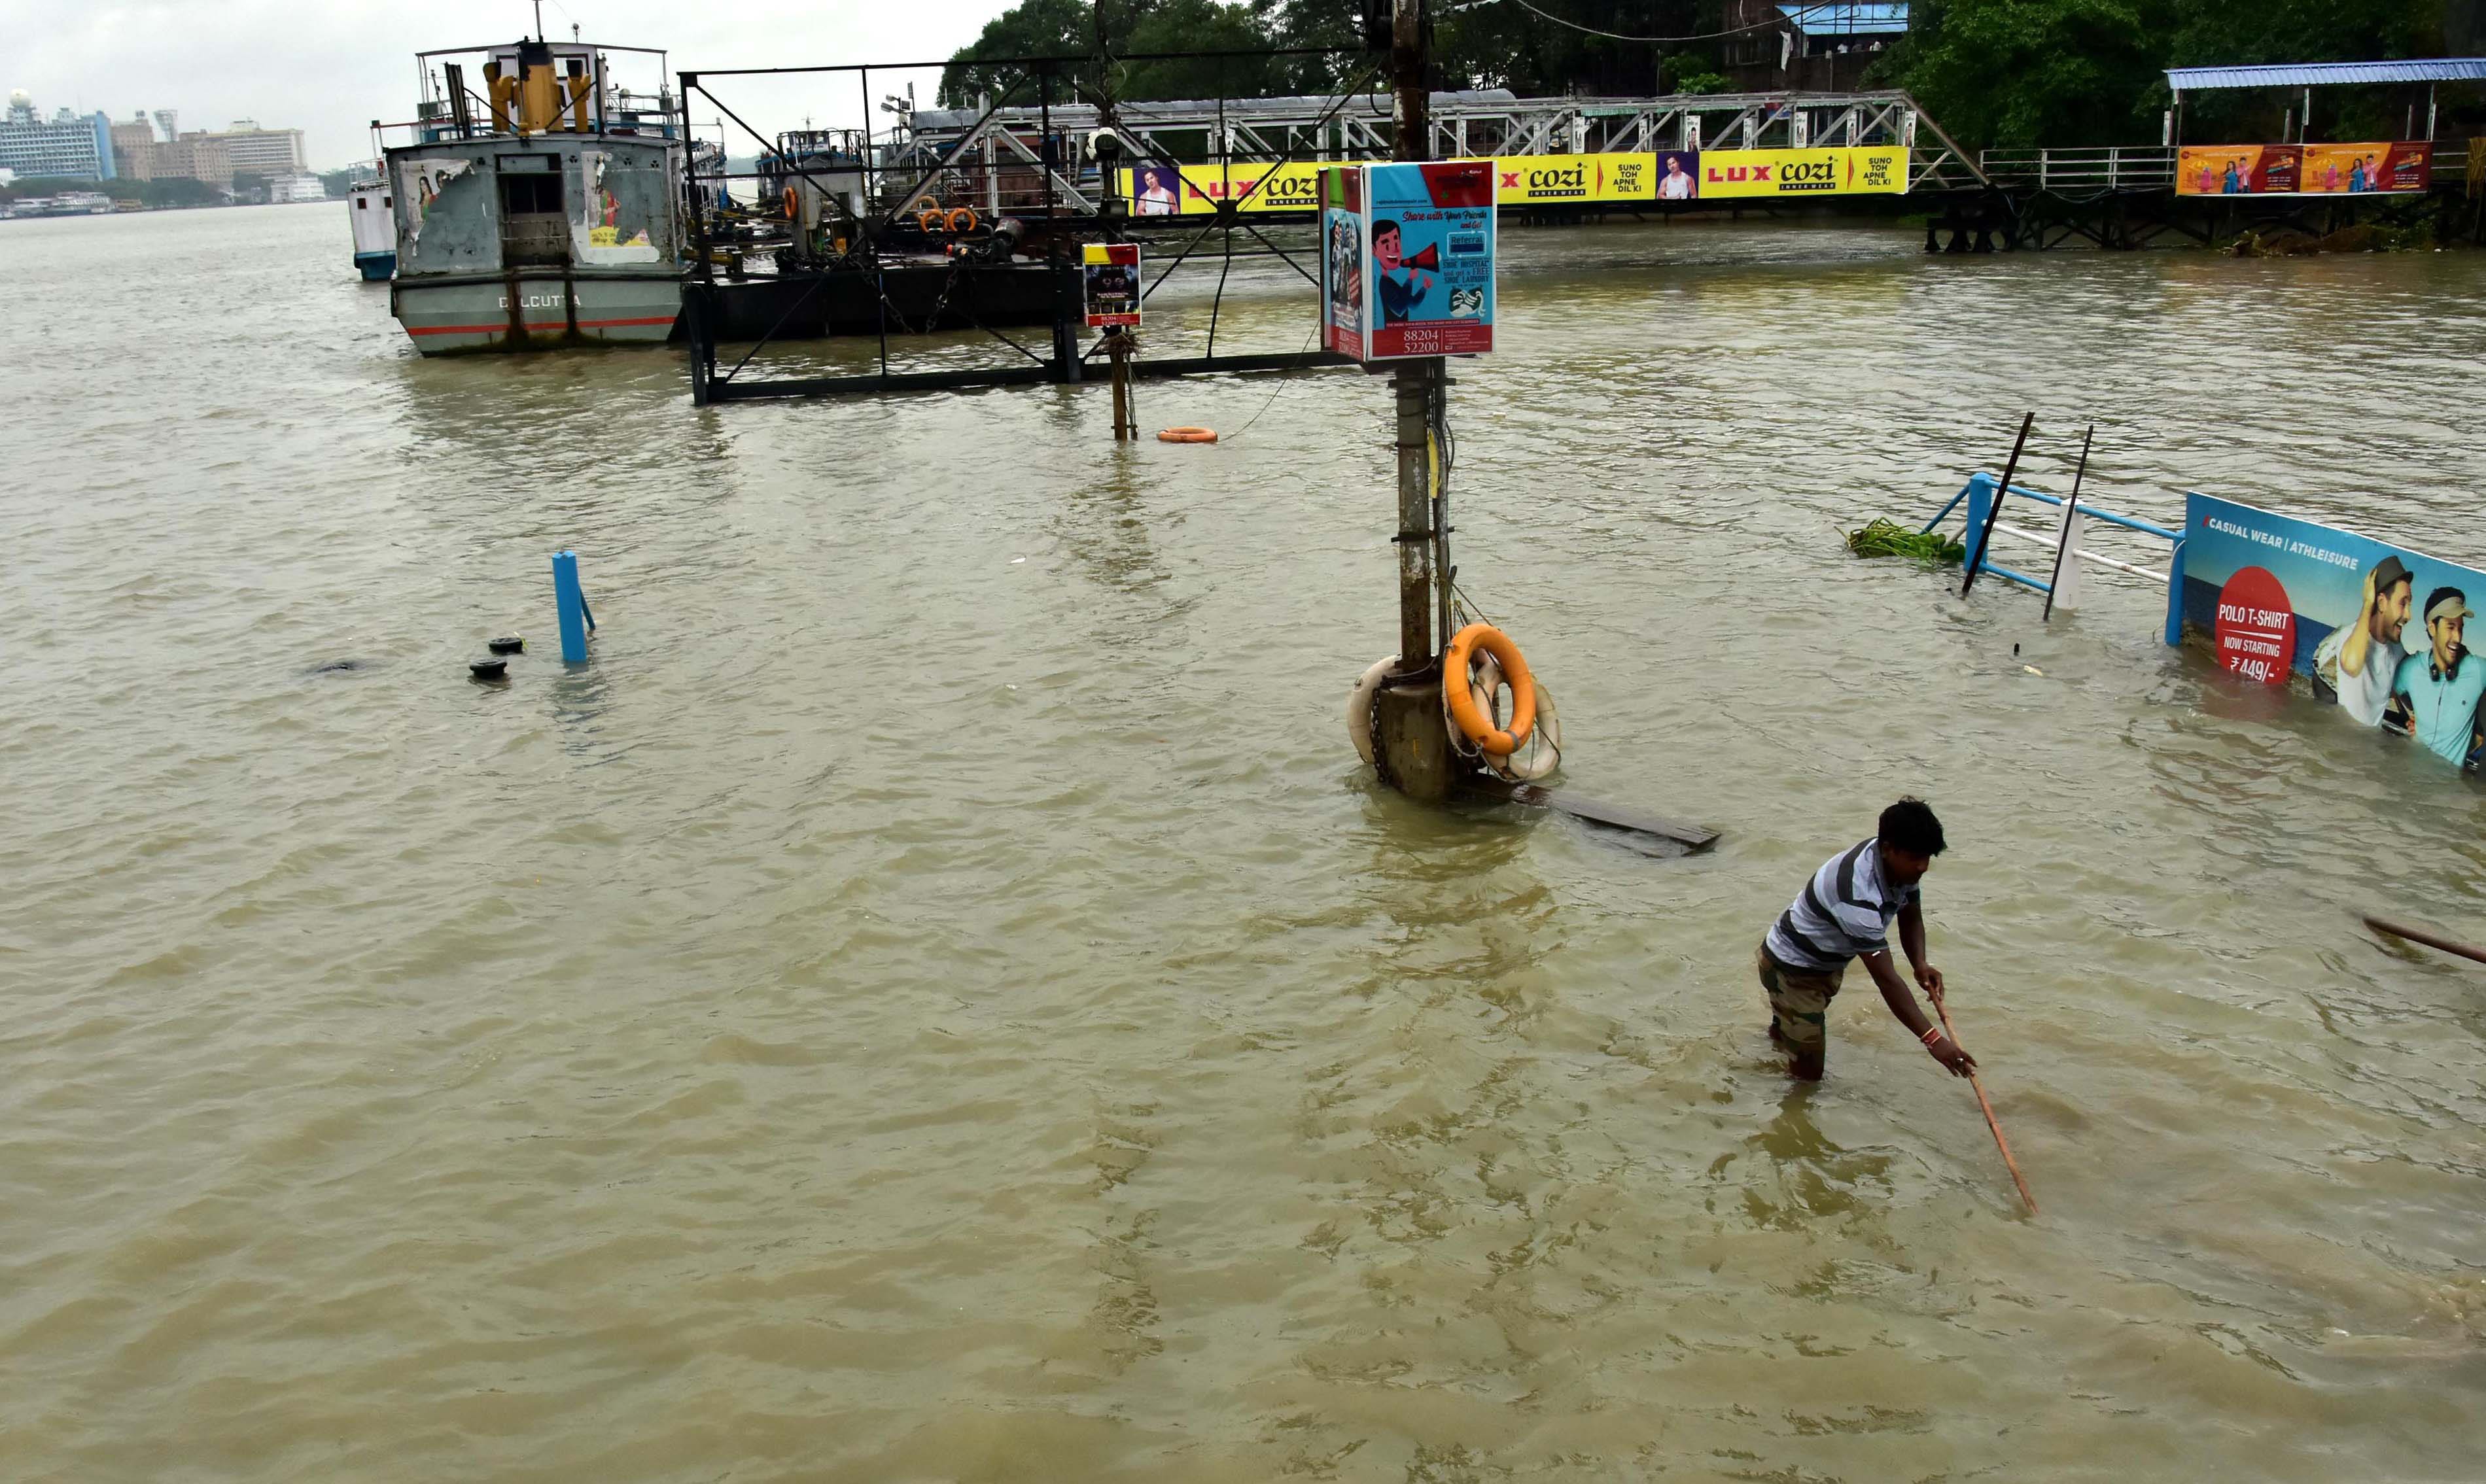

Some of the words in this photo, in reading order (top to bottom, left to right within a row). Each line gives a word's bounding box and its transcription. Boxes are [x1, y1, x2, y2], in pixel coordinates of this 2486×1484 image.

[1530, 162, 1586, 188] cozi
[1708, 166, 1771, 182] LUX
[1781, 156, 1836, 181] cozi
[1451, 235, 1482, 244] Referral
[499, 295, 581, 308] CLCUTA
[1404, 330, 1439, 341] 88204
[1404, 341, 1439, 353] 52200
[2209, 517, 2249, 539] CASUAL
[2251, 529, 2283, 549] WEAR
[2289, 541, 2359, 570] ATHLEISURE
[2218, 604, 2245, 623] POLO
[2249, 608, 2289, 629] T-SHIRT
[2224, 636, 2242, 650] NOW
[2243, 639, 2281, 657] STARTING
